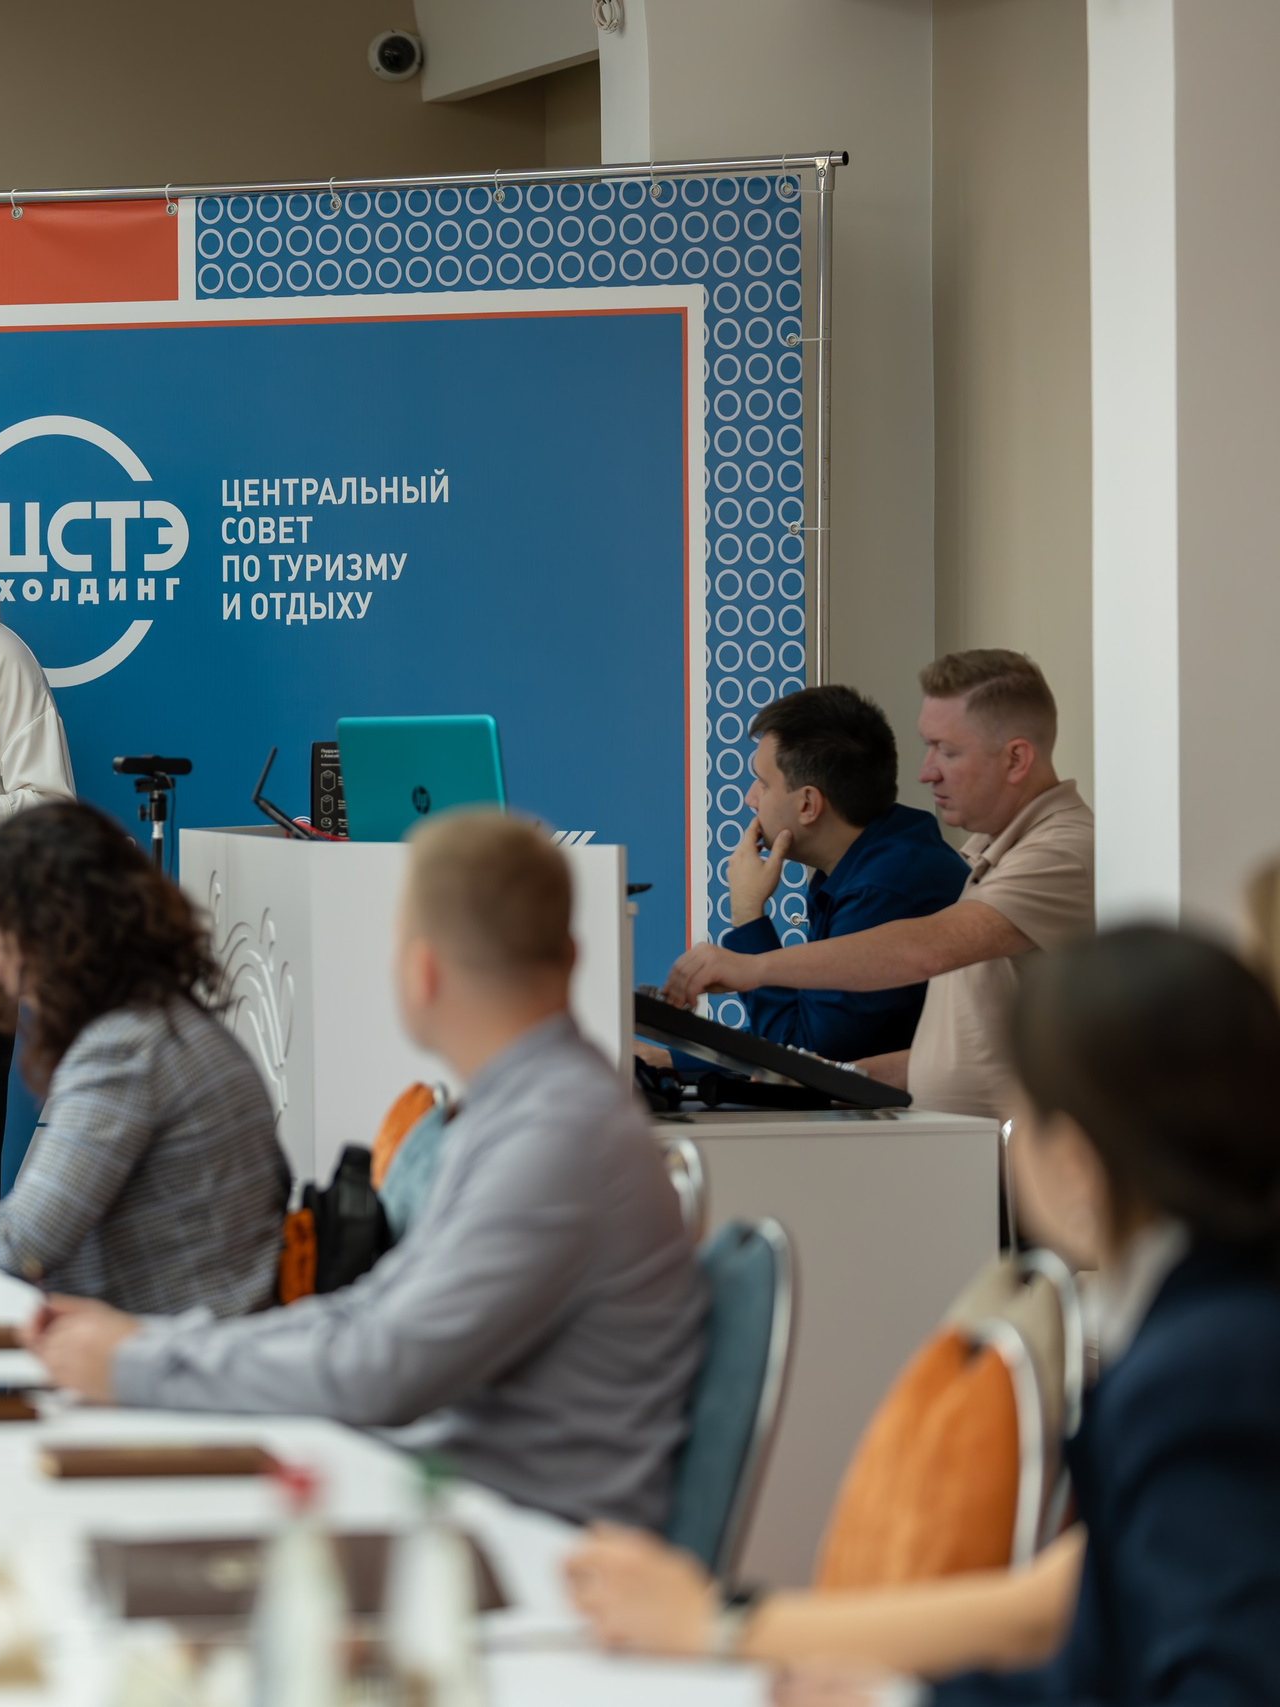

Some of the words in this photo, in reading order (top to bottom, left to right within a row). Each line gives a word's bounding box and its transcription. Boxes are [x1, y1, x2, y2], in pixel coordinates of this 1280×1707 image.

[222, 469, 448, 512] ЦЕНТРАЛЬНЫЙ
[222, 516, 313, 544] СОВЕТ
[223, 555, 260, 582] ПО
[269, 553, 407, 581] ТУРИЗМУ
[223, 593, 240, 620] И
[251, 592, 373, 625] ОТДЫХУ
